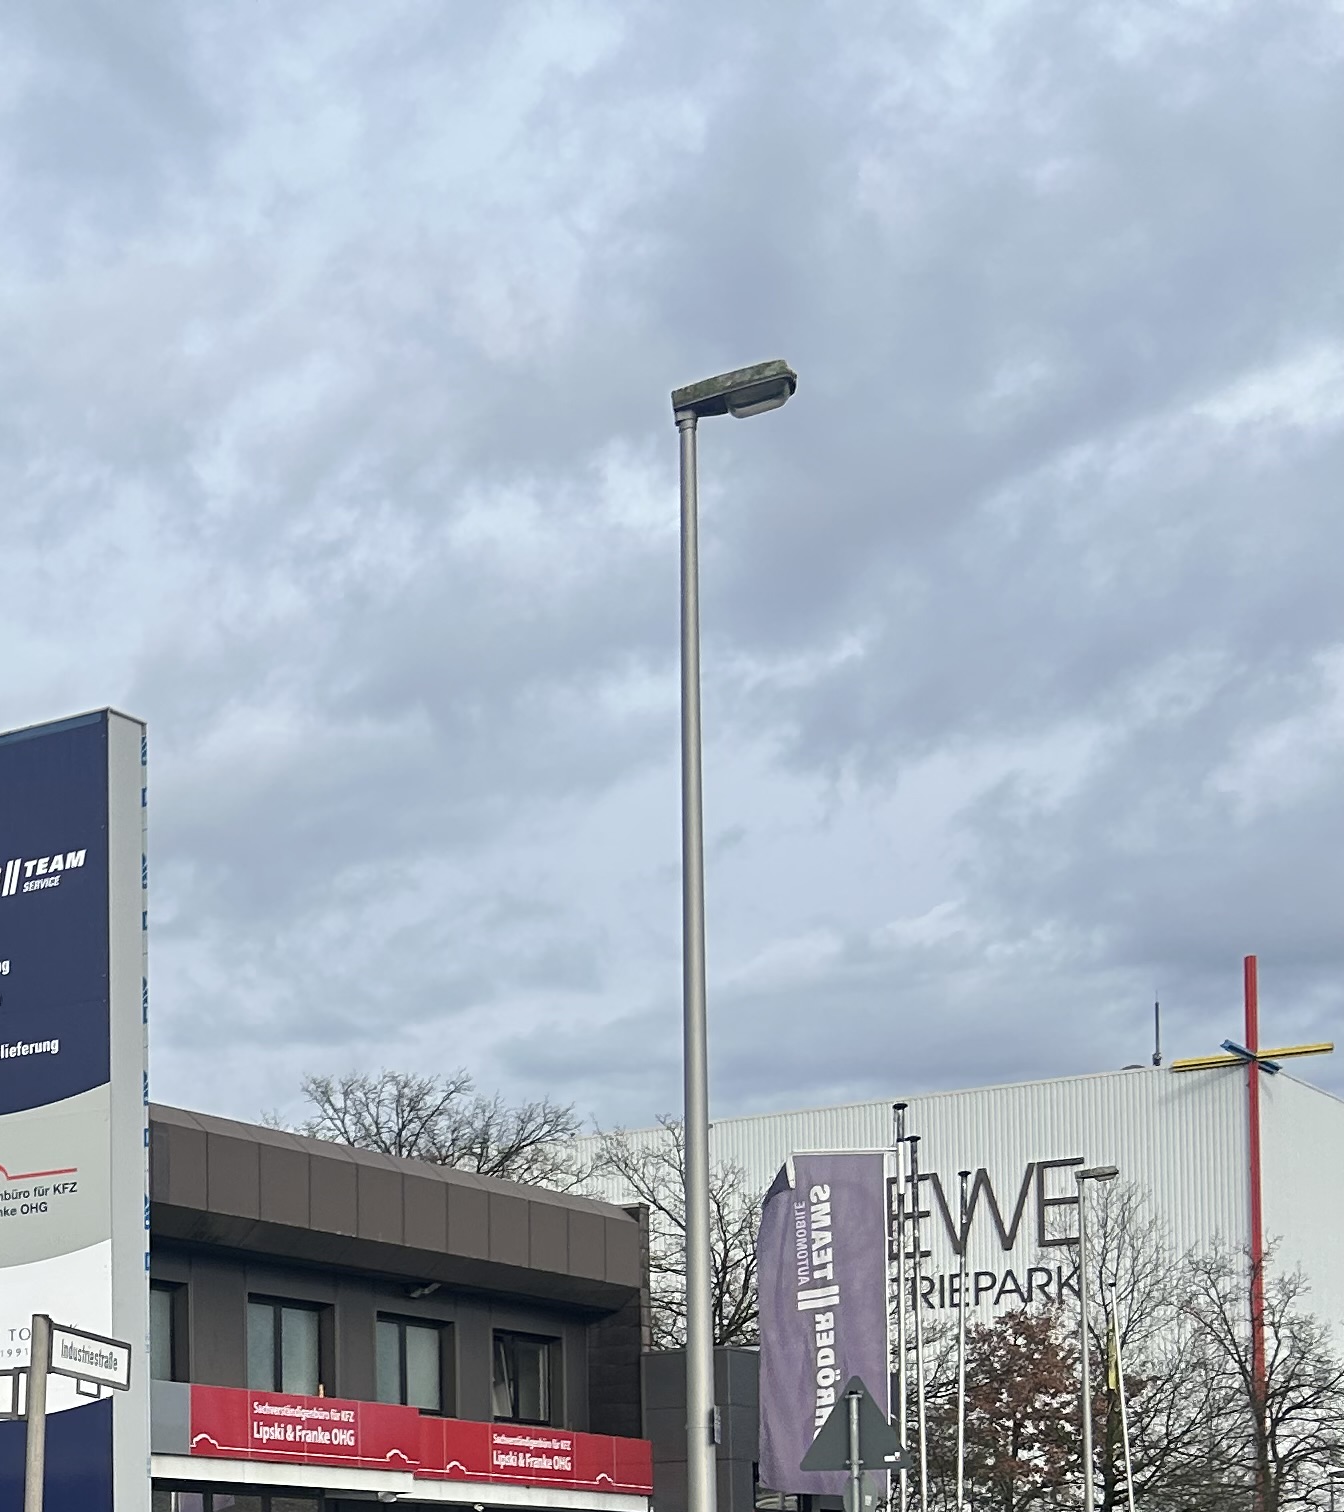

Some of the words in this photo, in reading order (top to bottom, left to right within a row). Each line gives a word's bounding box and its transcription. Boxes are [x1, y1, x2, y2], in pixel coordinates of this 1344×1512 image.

[24, 849, 87, 877] TEAM
[22, 875, 60, 893] SERVICE
[33, 1185, 50, 1198] für
[52, 1182, 78, 1194] KFZ
[20, 1202, 48, 1215] OHG
[887, 1157, 1084, 1260] EWE
[0, 1348, 29, 1359] 1991
[61, 1338, 118, 1371] Industriestraße
[253, 1421, 284, 1443] Lipski
[286, 1424, 295, 1441] &
[296, 1425, 330, 1444] Franke
[332, 1429, 355, 1446] OHG
[493, 1450, 517, 1469] Lipski
[526, 1453, 552, 1469] Franke
[553, 1456, 572, 1471] OHG
